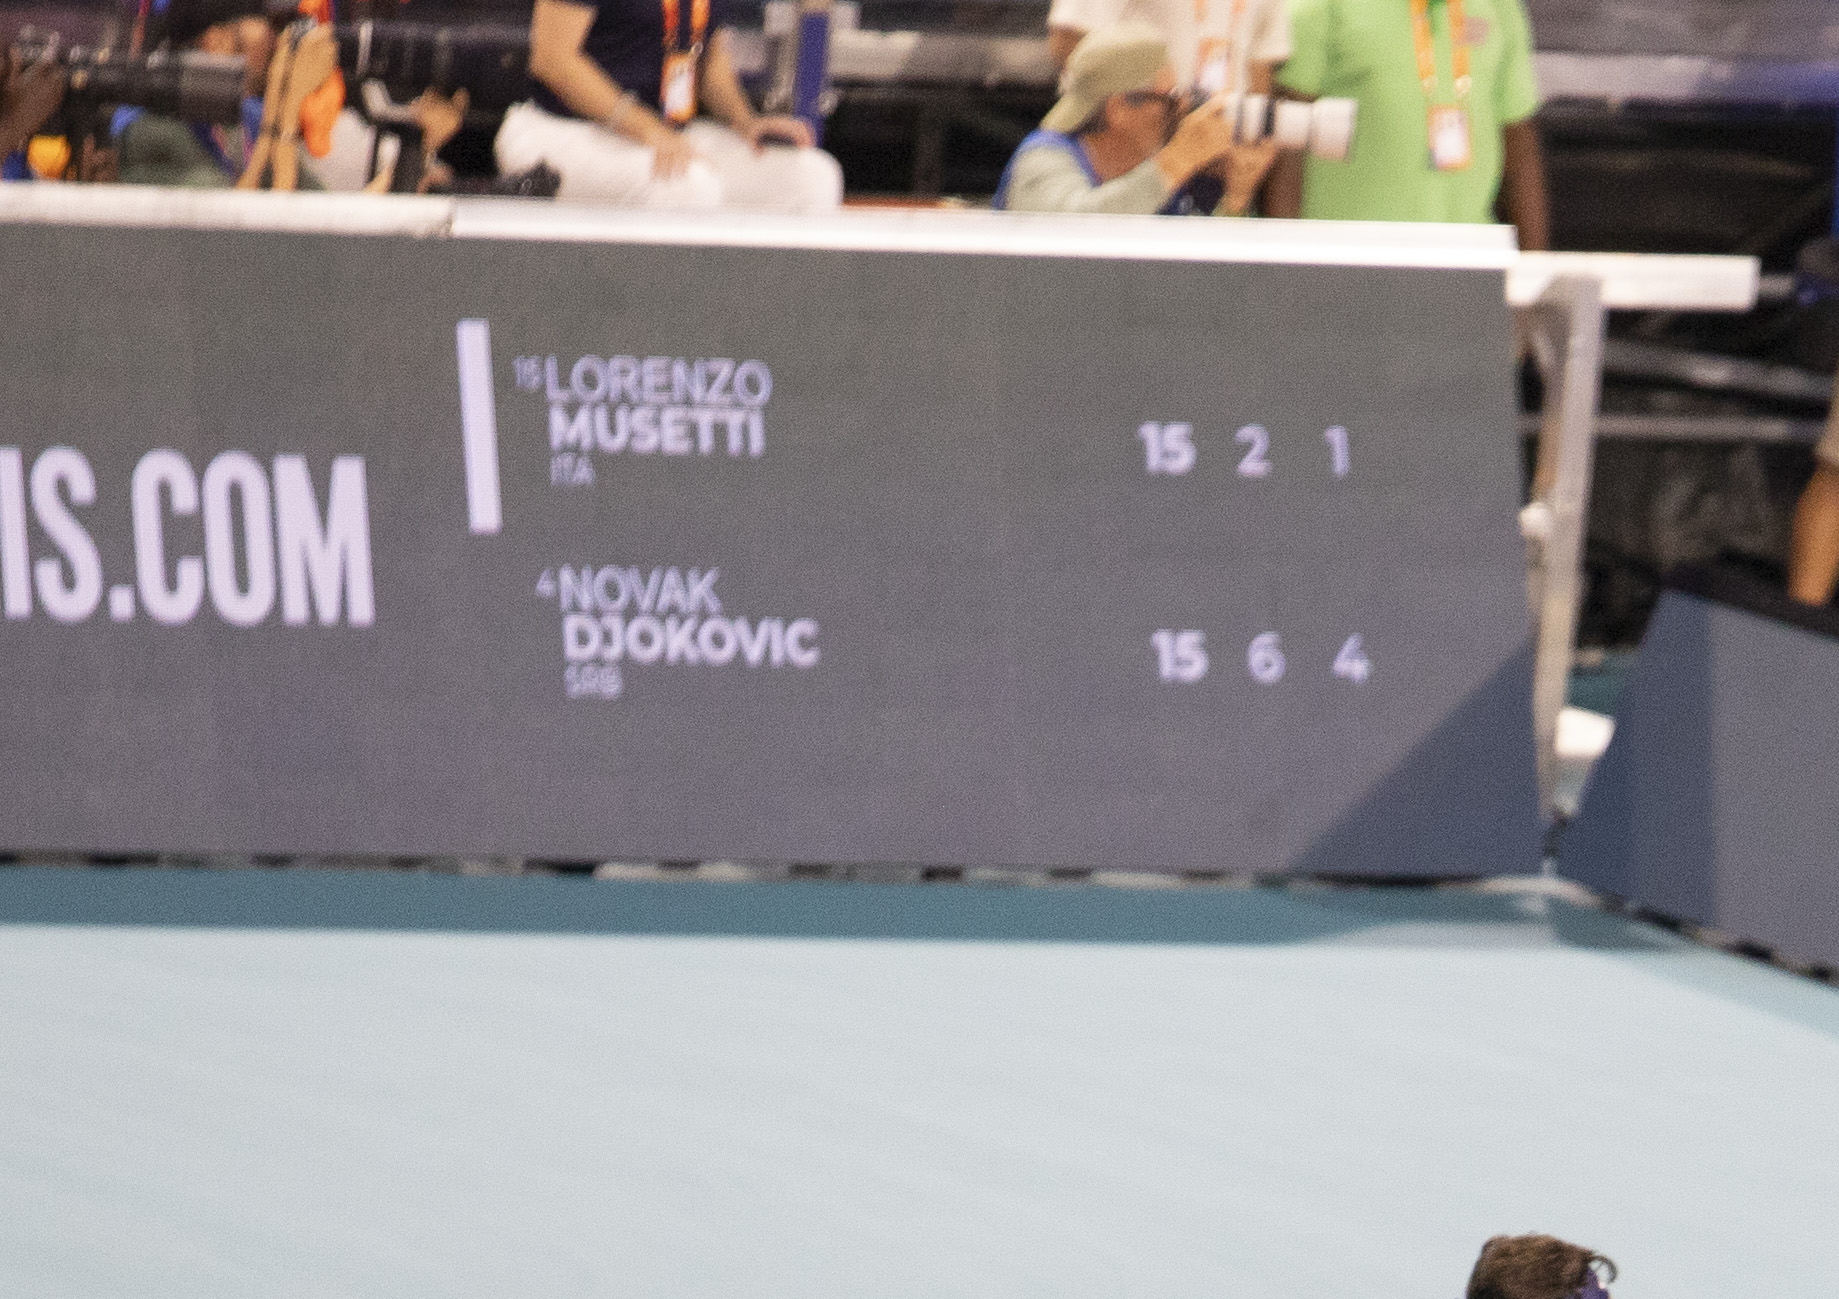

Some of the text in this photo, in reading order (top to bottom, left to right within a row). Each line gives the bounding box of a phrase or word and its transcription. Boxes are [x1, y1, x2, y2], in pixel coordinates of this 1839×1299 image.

[545, 354, 774, 407] LORENZO
[549, 401, 766, 459] MUSETTI
[1138, 420, 1350, 478] 15 2 1
[558, 563, 724, 615] NOVAK
[563, 614, 820, 669] DJOKOVIC
[1151, 628, 1374, 684] 15 6 4
